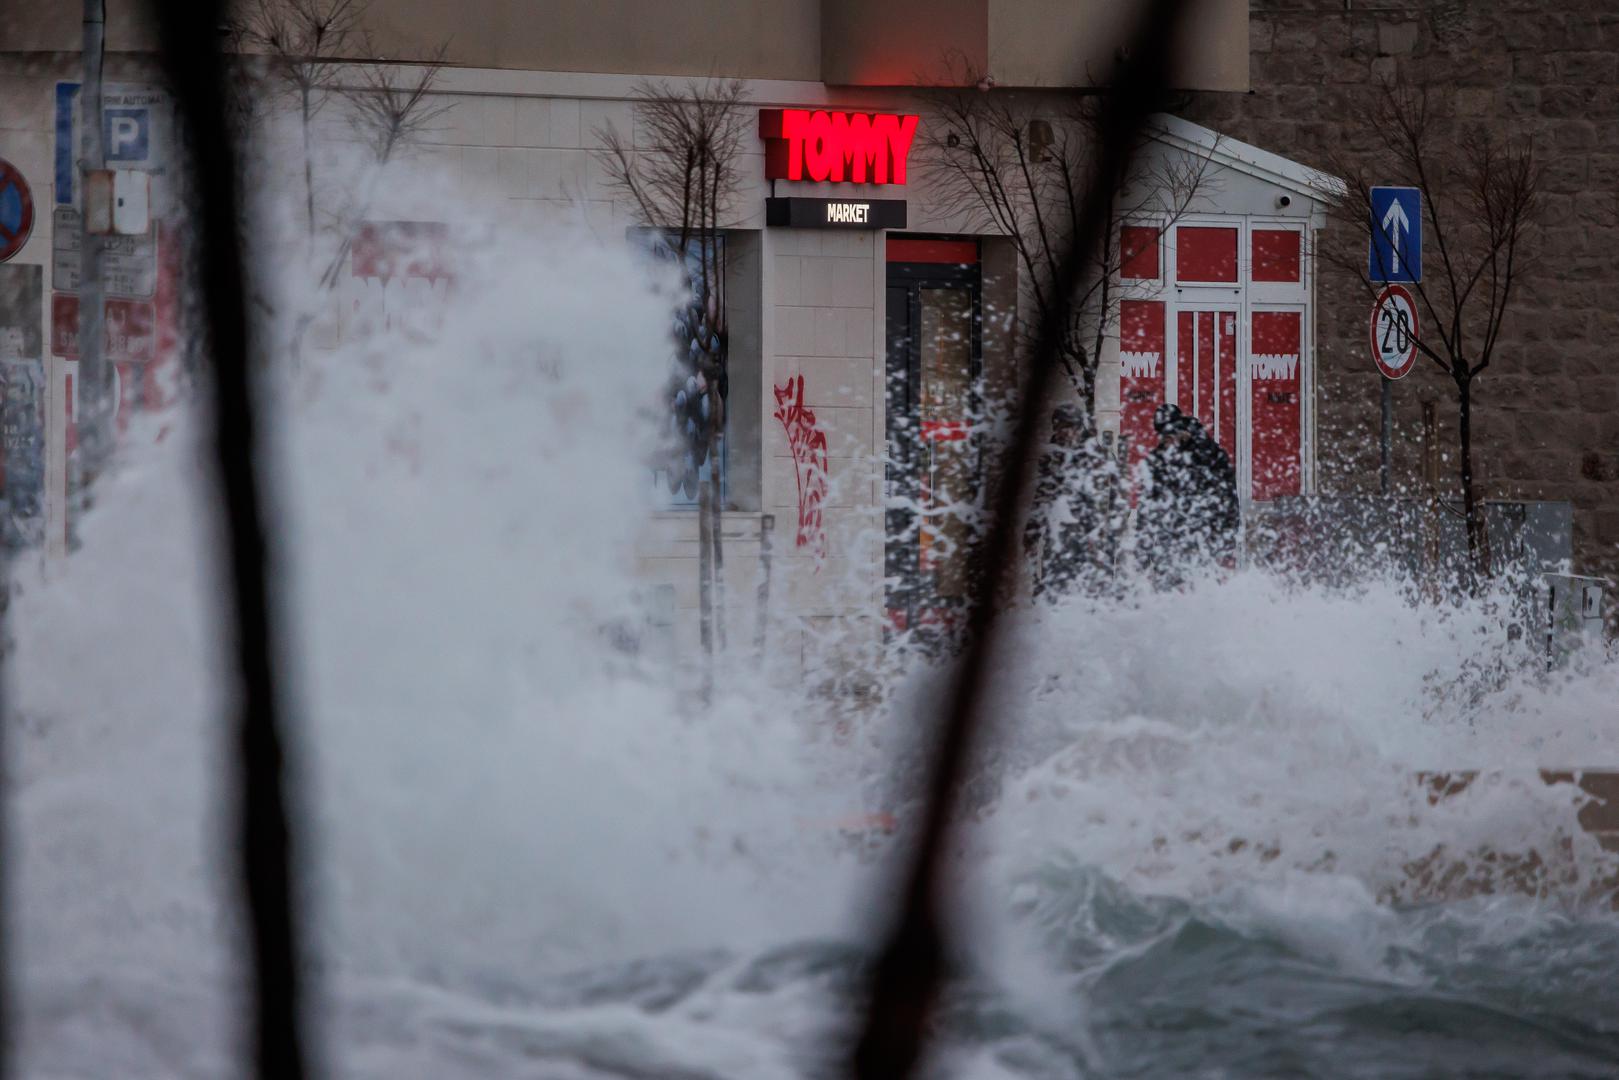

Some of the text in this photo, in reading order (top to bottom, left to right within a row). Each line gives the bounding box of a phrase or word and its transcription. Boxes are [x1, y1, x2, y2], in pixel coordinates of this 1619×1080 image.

[111, 117, 139, 155] P
[782, 109, 919, 185] TOMMY
[827, 203, 870, 223] MARKET
[1381, 309, 1409, 354] 20
[1120, 351, 1160, 378] OMMY
[1251, 353, 1299, 380] TOMMY
